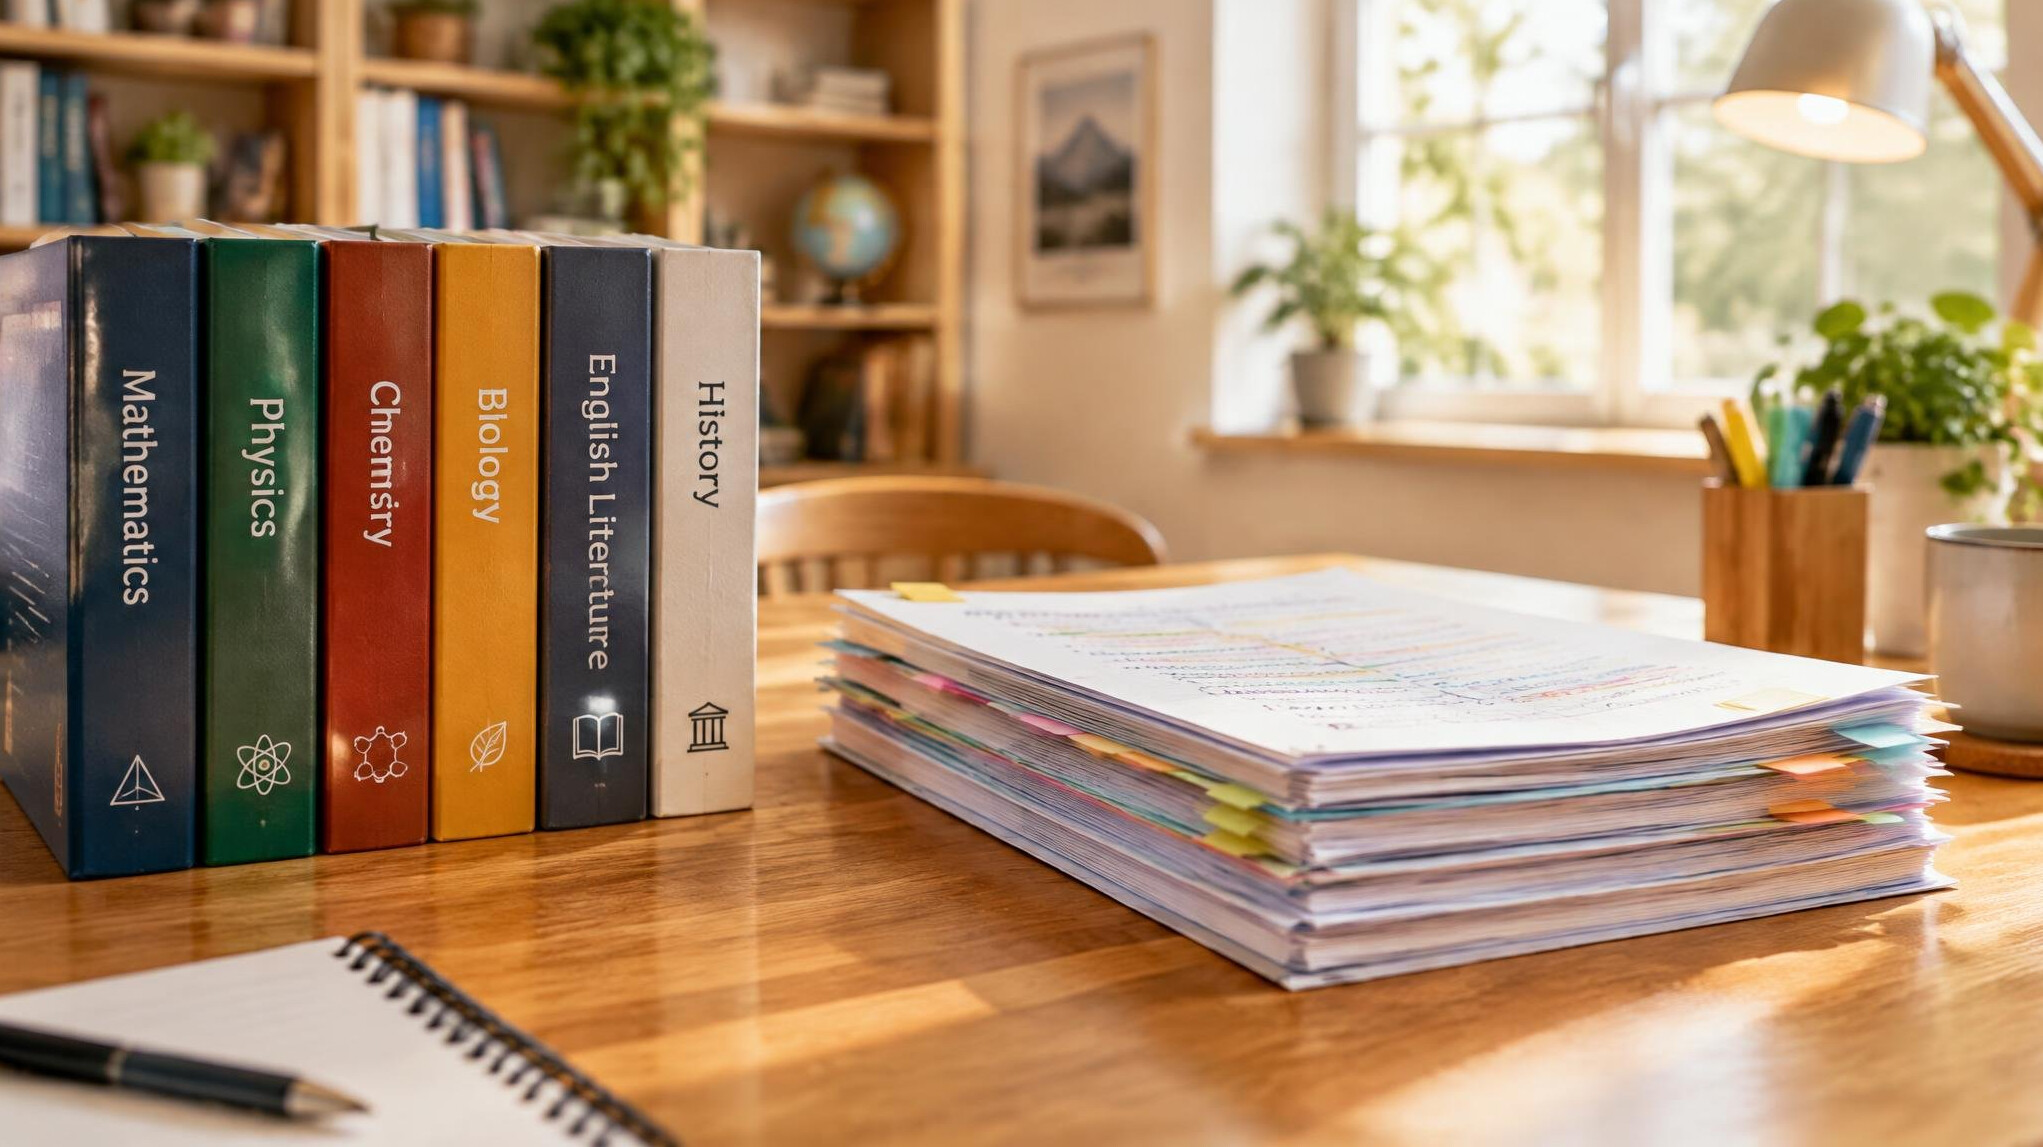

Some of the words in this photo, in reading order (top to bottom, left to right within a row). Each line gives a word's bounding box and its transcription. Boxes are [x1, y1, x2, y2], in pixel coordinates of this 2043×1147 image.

[241, 397, 285, 538] Physics
[581, 354, 619, 483] English
[692, 380, 726, 509] History
[122, 368, 159, 606] Mathematics
